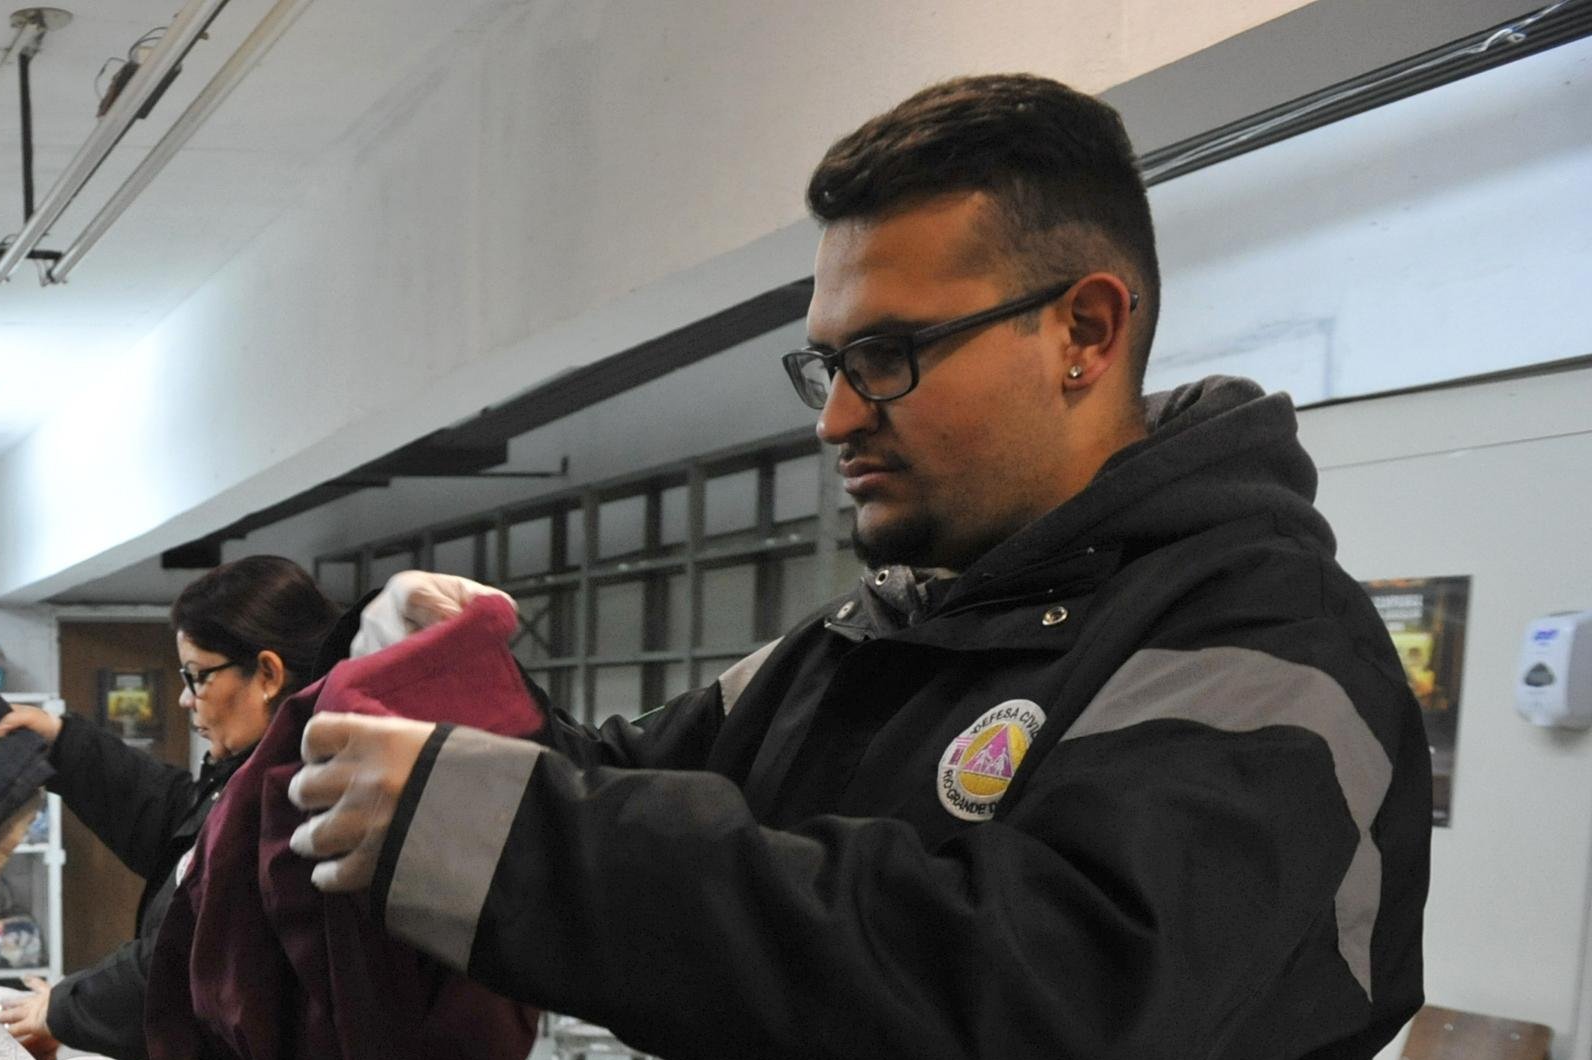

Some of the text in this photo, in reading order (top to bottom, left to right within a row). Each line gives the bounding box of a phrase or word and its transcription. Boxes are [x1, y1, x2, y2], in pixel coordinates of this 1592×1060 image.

[970, 707, 1019, 735] DEFESA
[943, 769, 954, 789] RIO
[946, 789, 985, 815] GRANDE
